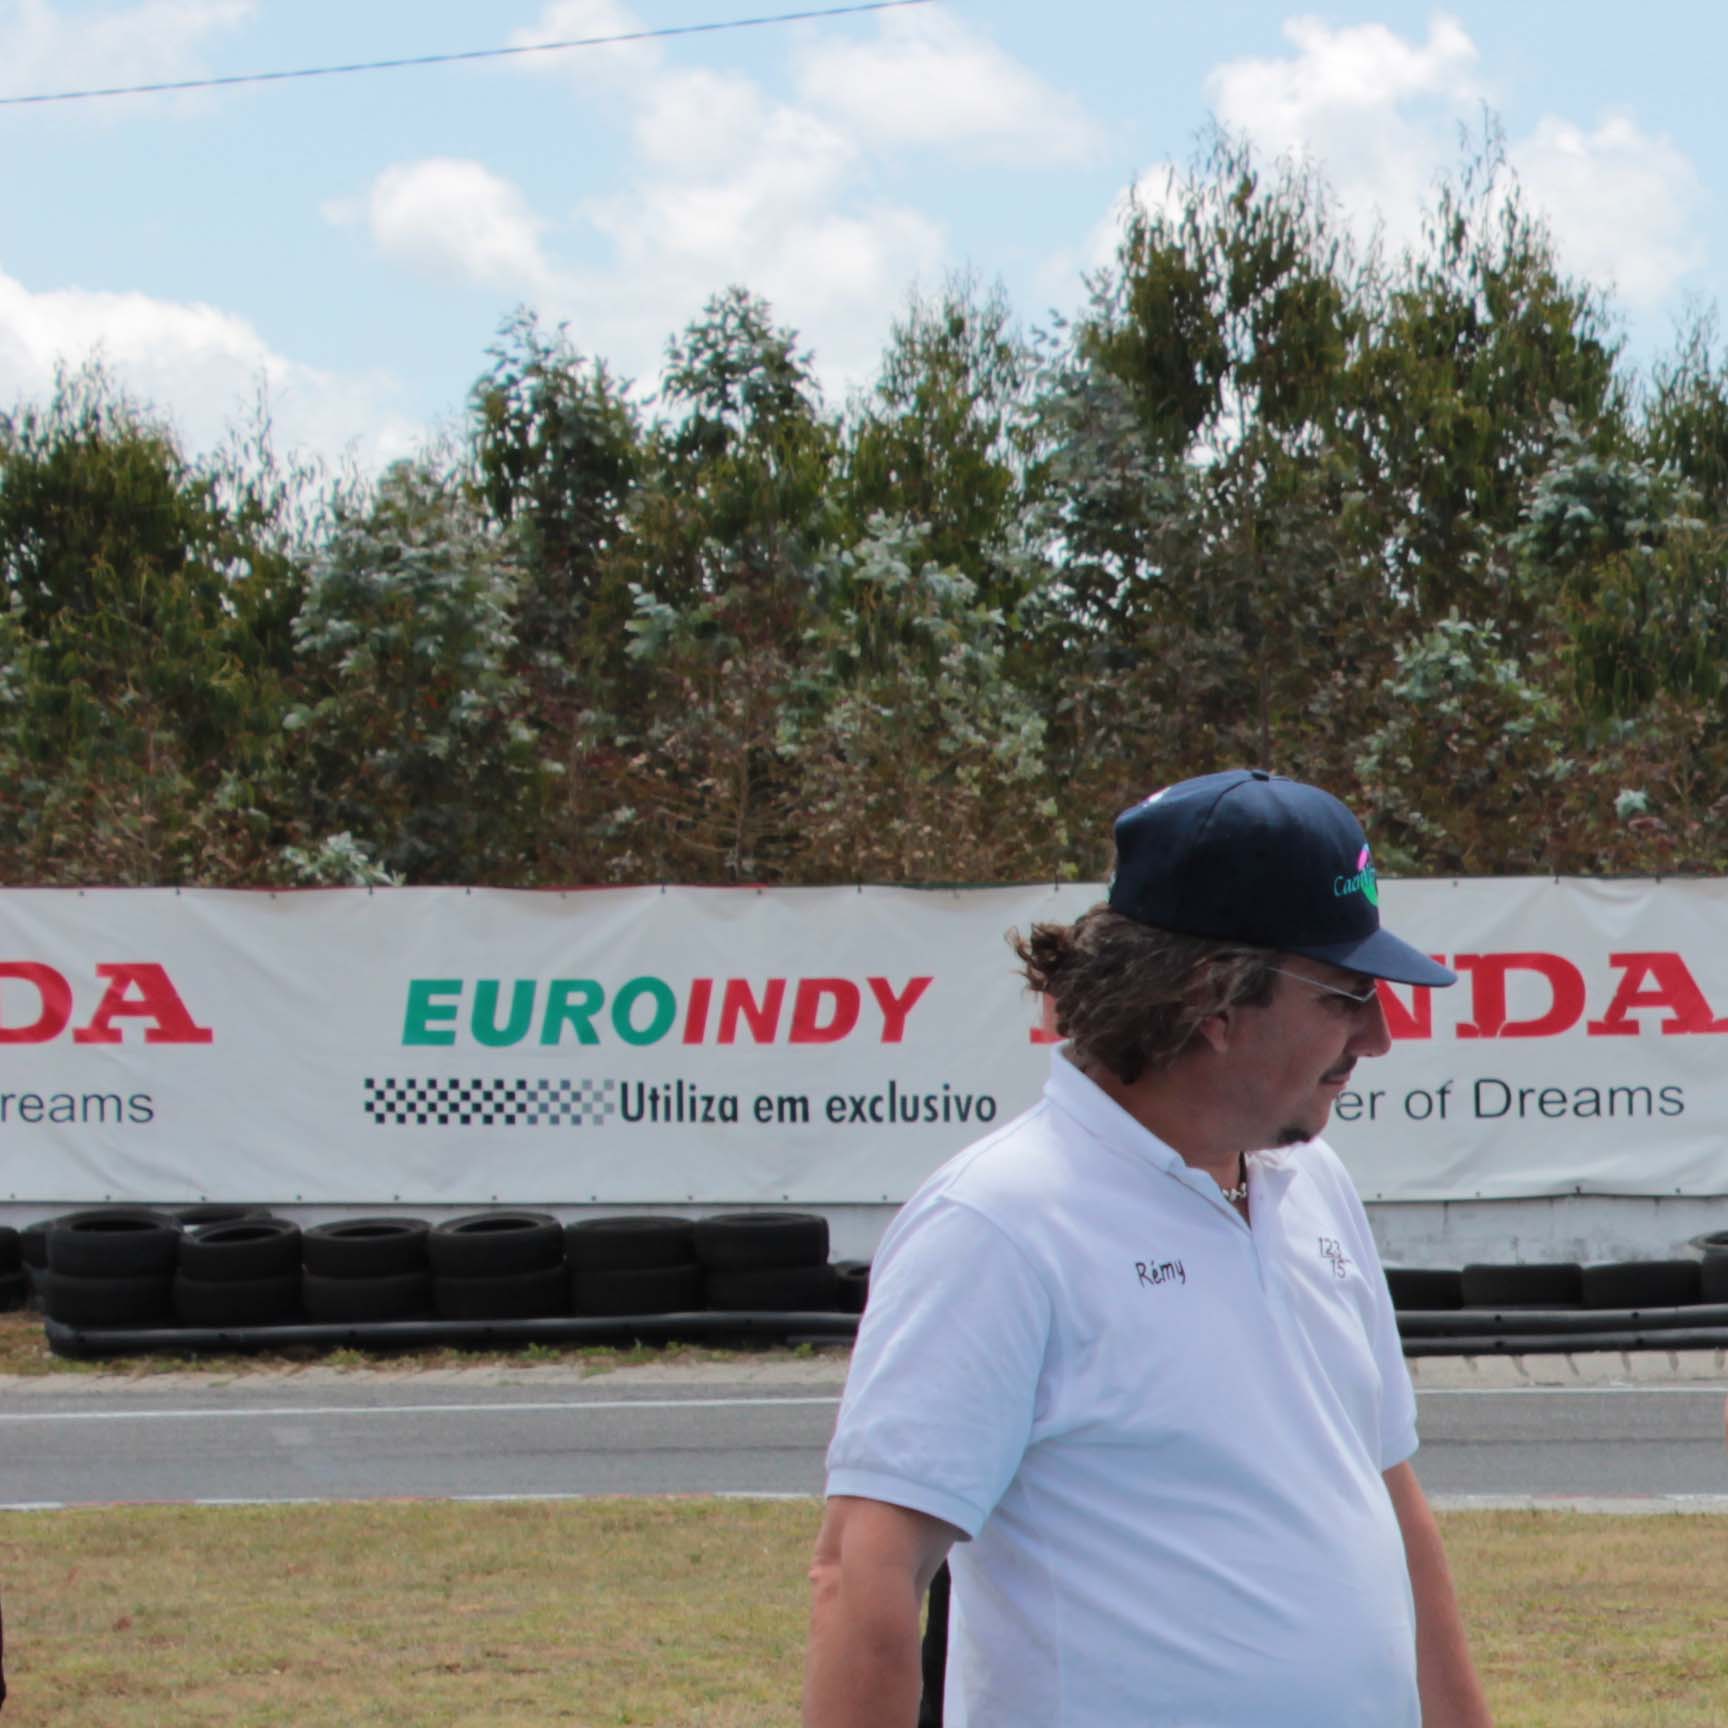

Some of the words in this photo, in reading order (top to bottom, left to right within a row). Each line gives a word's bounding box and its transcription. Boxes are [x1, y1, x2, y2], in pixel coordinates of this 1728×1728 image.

[401, 975, 935, 1047] EUROINDY
[620, 1078, 739, 1124] Utiliza
[753, 1093, 810, 1123] em
[825, 1079, 997, 1124] exclusivo
[1403, 1079, 1454, 1120] of
[1473, 1077, 1685, 1119] Dreams
[1135, 1259, 1187, 1289] Rémy
